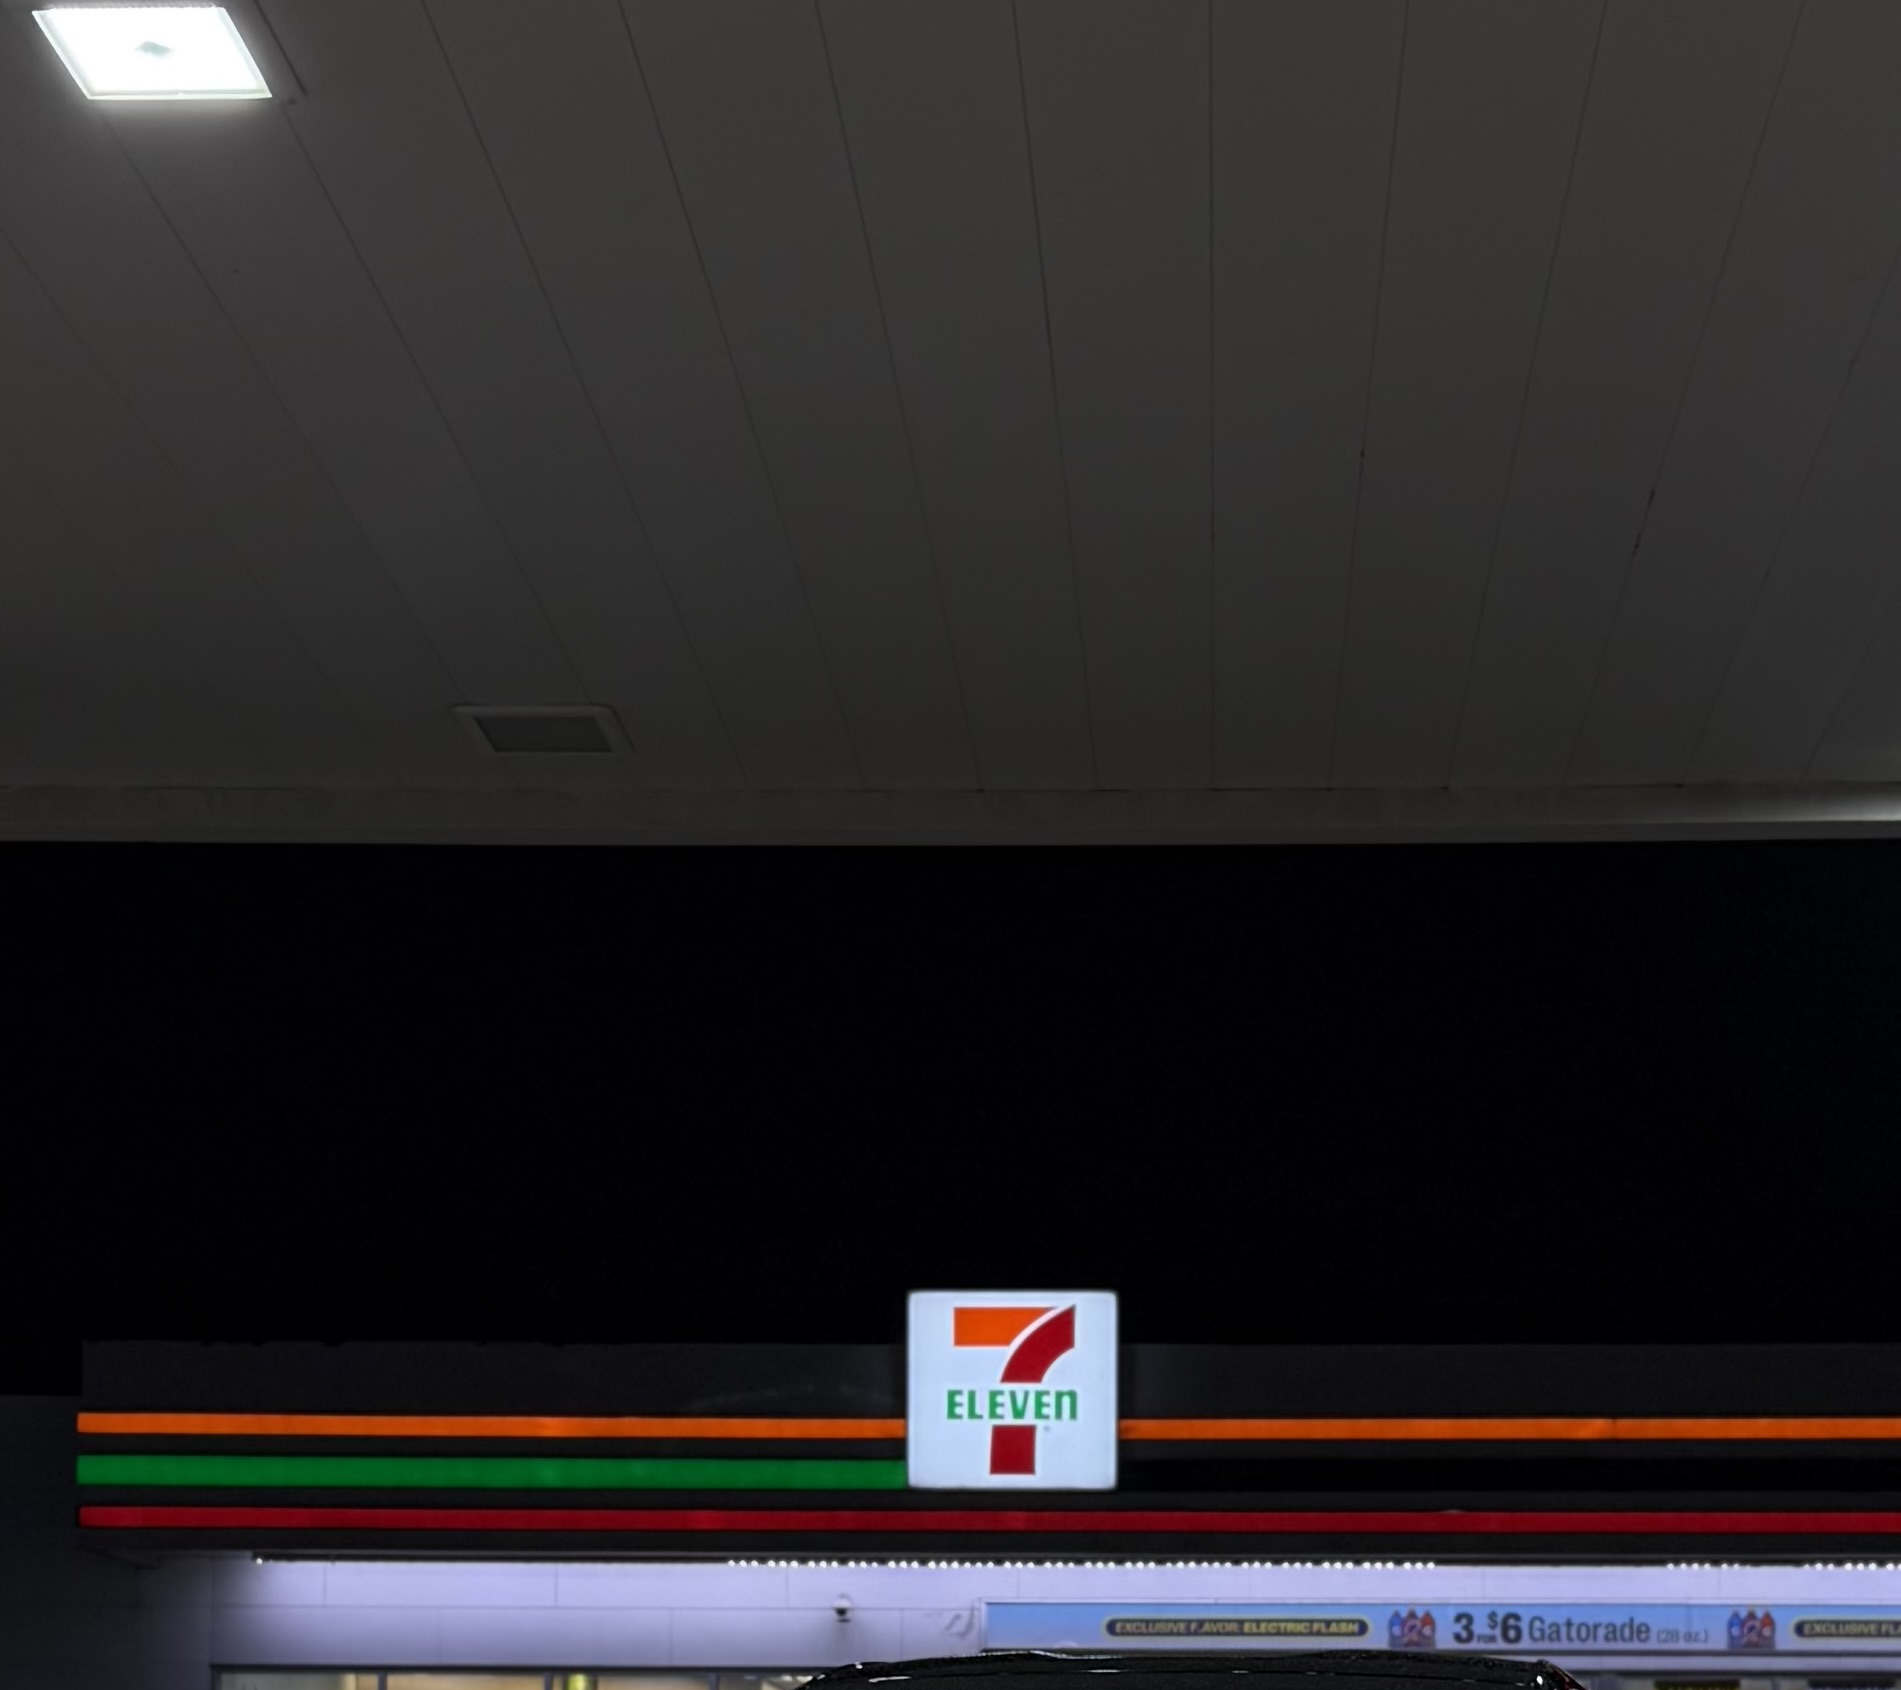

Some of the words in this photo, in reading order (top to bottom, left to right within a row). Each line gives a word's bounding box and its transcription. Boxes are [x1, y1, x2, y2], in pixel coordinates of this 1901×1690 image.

[953, 1304, 1076, 1475] 7
[1115, 1622, 1187, 1634] EXCLUSIVE
[1243, 1622, 1310, 1634] ELECTRIC
[1312, 1622, 1359, 1634] FLASH
[1453, 1612, 1474, 1644] 3
[1528, 1616, 1651, 1643] Gatorade
[1803, 1623, 1878, 1635] EXCLUSIVE
